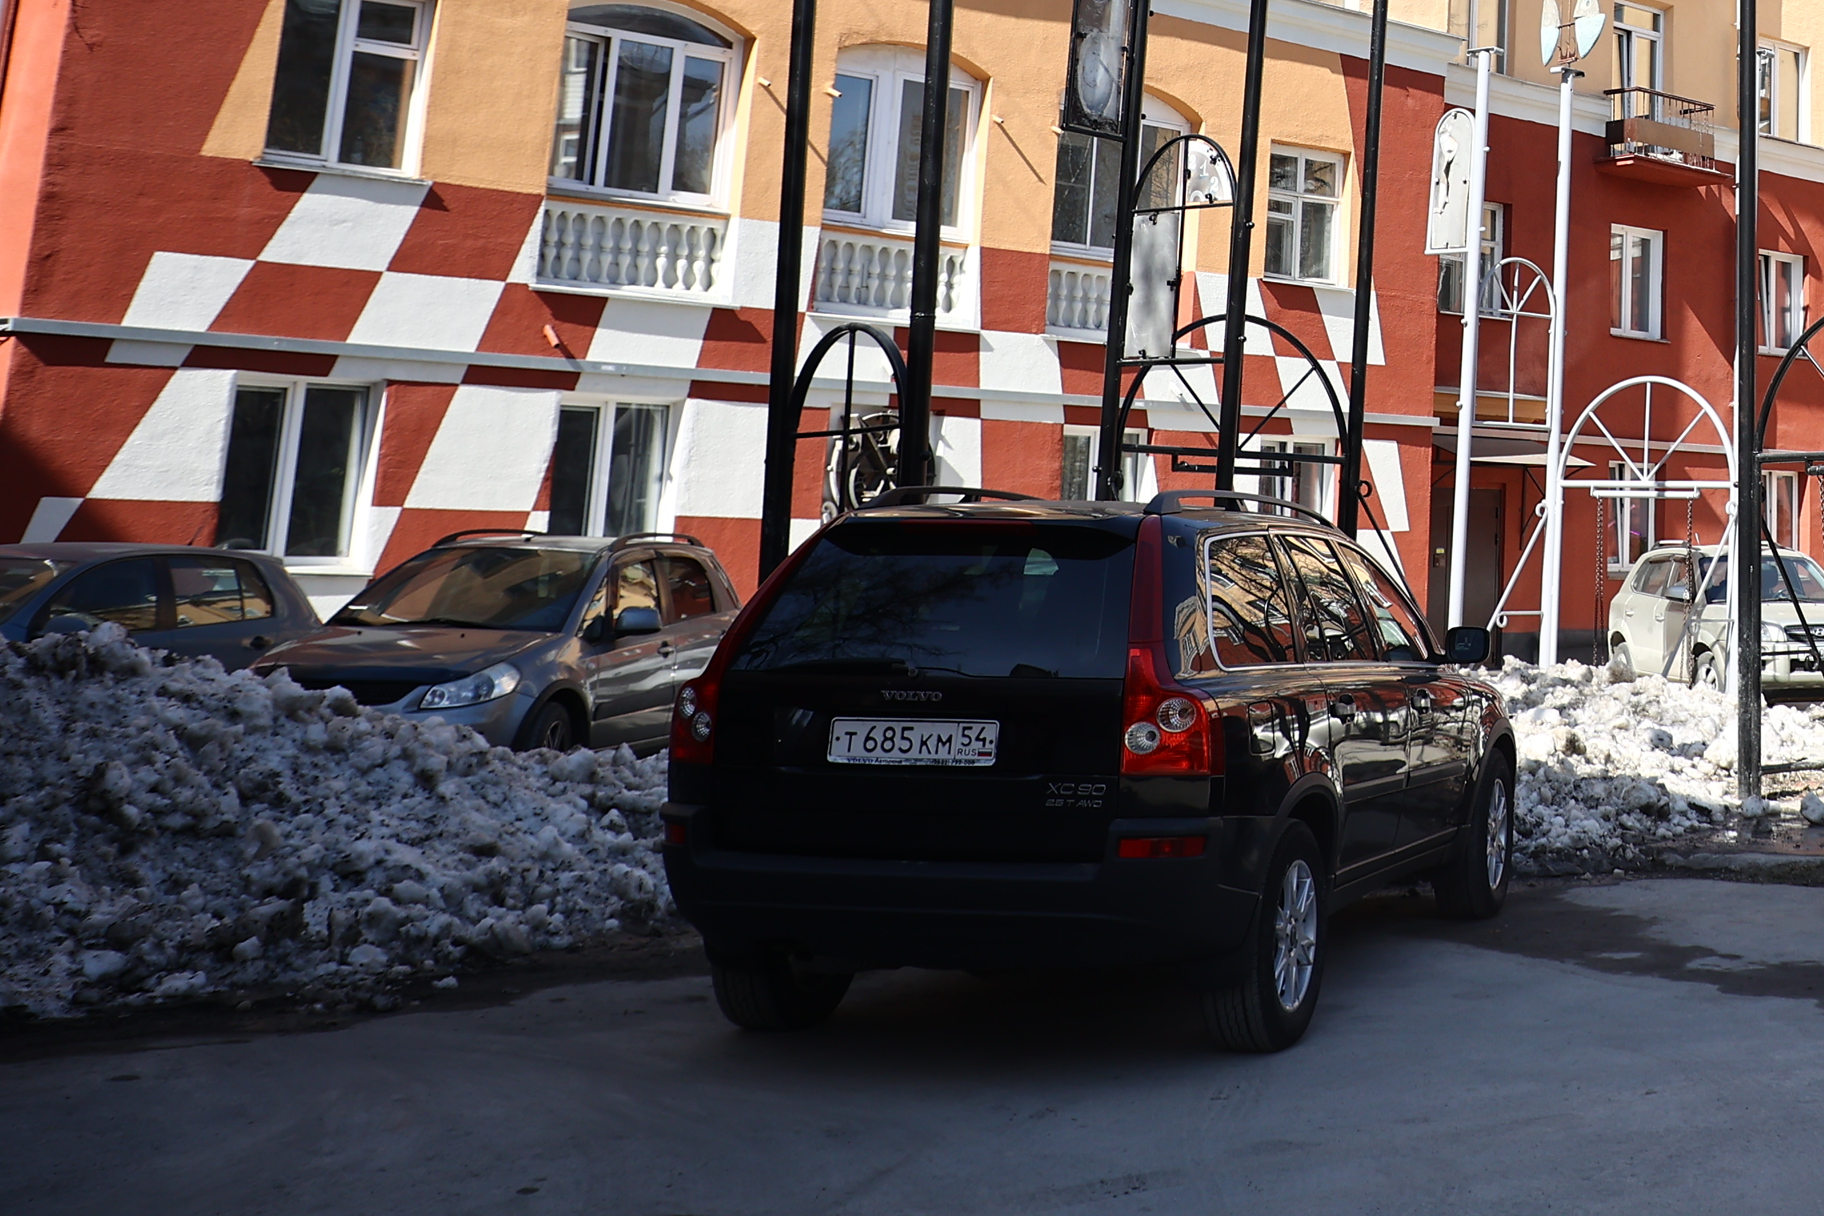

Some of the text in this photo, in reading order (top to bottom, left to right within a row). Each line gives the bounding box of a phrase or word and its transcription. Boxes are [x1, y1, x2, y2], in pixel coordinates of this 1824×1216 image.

[1200, 159, 1209, 177] 1
[1210, 176, 1219, 193] 2
[881, 690, 943, 701] VOLVO
[961, 727, 987, 748] 54
[957, 748, 977, 757] RUS
[1076, 799, 1103, 808] AWD
